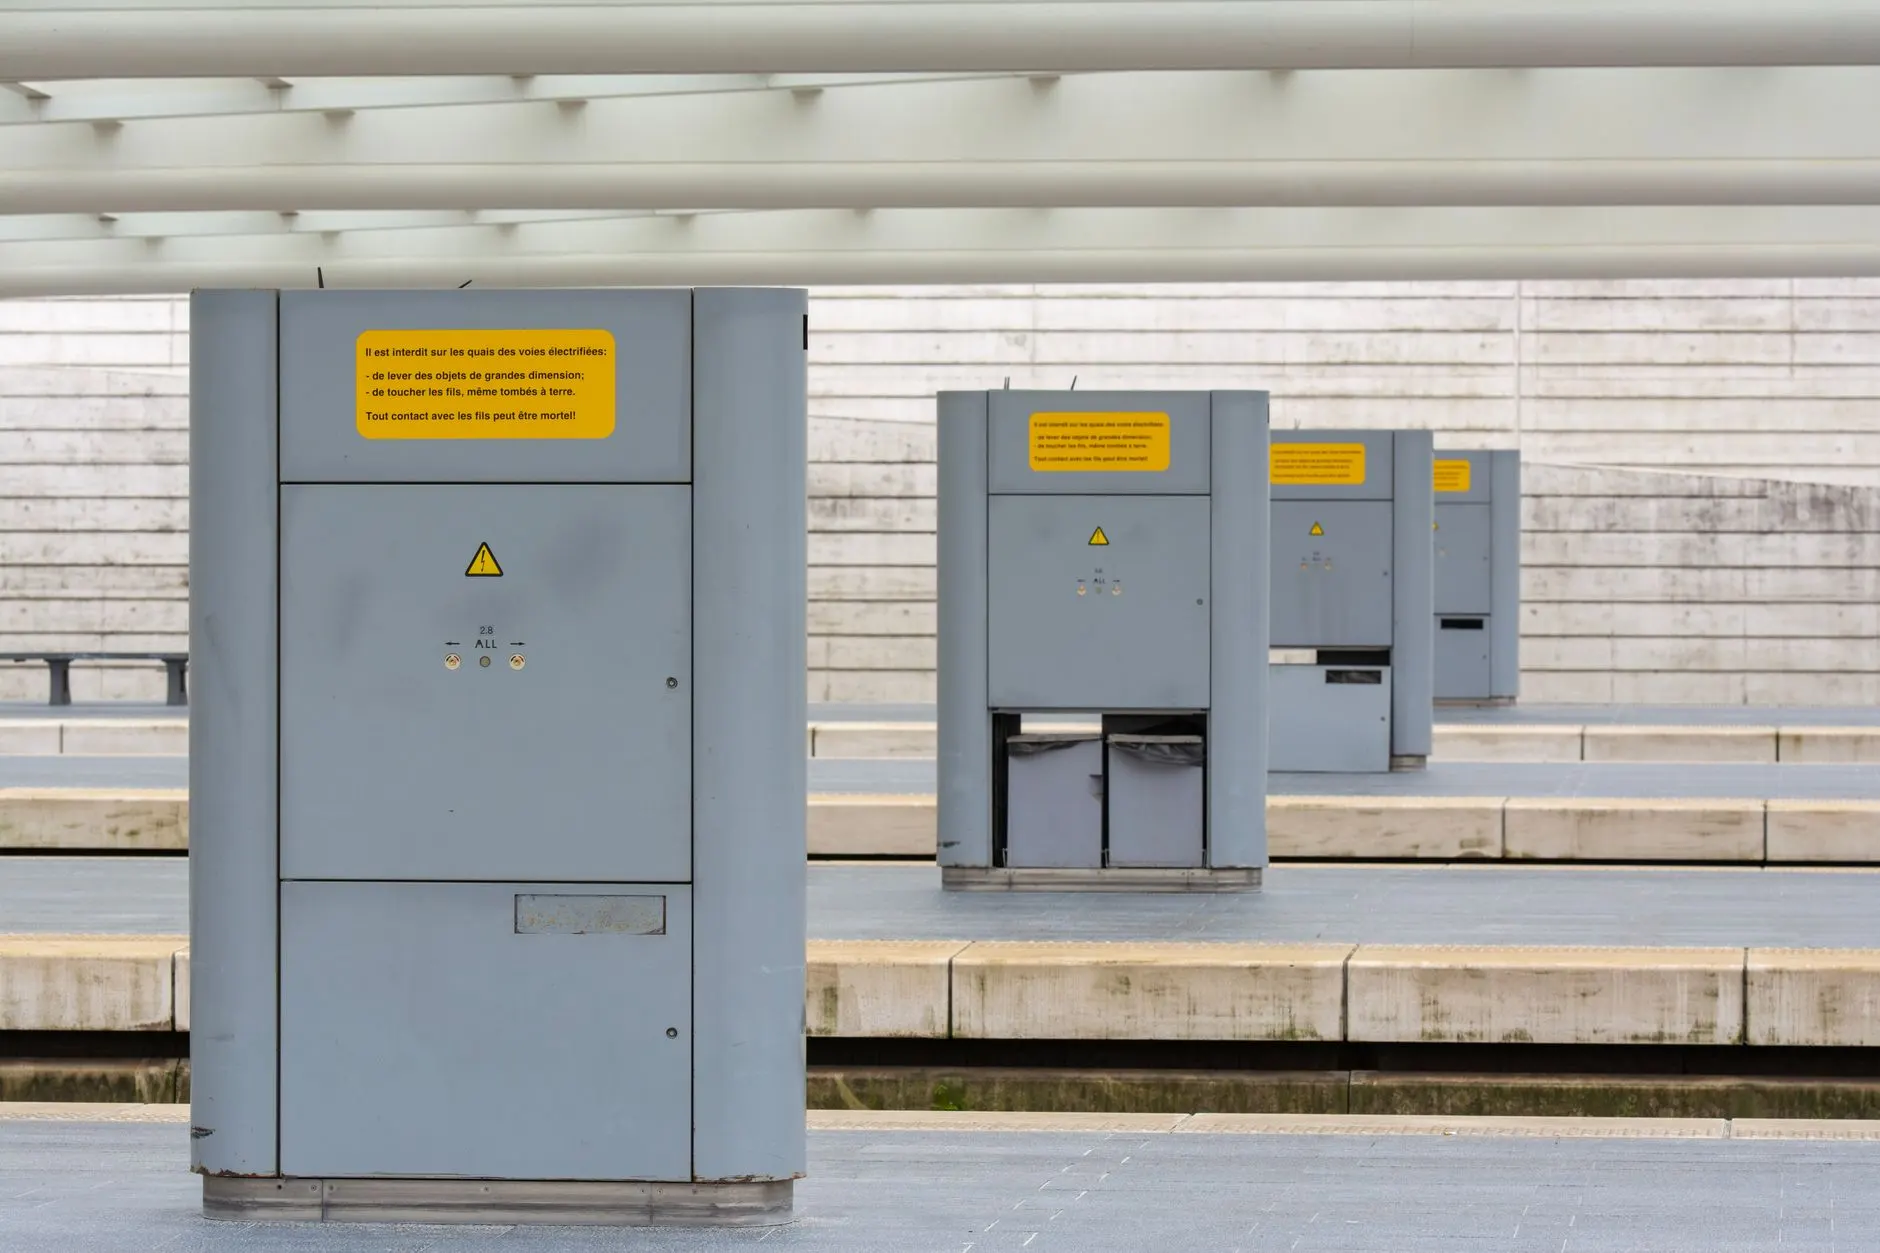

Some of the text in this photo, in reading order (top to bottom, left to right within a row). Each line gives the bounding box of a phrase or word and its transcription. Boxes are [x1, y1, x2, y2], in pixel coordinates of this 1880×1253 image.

[365, 346, 607, 359] Il est interdit sur les quais des voies électrifiées:
[372, 371, 385, 381] de
[387, 371, 413, 381] lever
[414, 371, 433, 381] des
[435, 371, 467, 383] objets
[469, 371, 482, 380] de
[484, 370, 526, 383] grandes
[528, 370, 584, 382] dimension;
[371, 387, 385, 397] de
[387, 387, 426, 397] toucher
[428, 387, 444, 397] les
[446, 387, 465, 398] fils,
[467, 386, 498, 397] même
[500, 386, 538, 396] tombés
[540, 386, 547, 396] à
[549, 387, 576, 396] terre.
[365, 410, 576, 423] Tout contact avec les fils peut être mortel!
[474, 639, 498, 649] ALL
